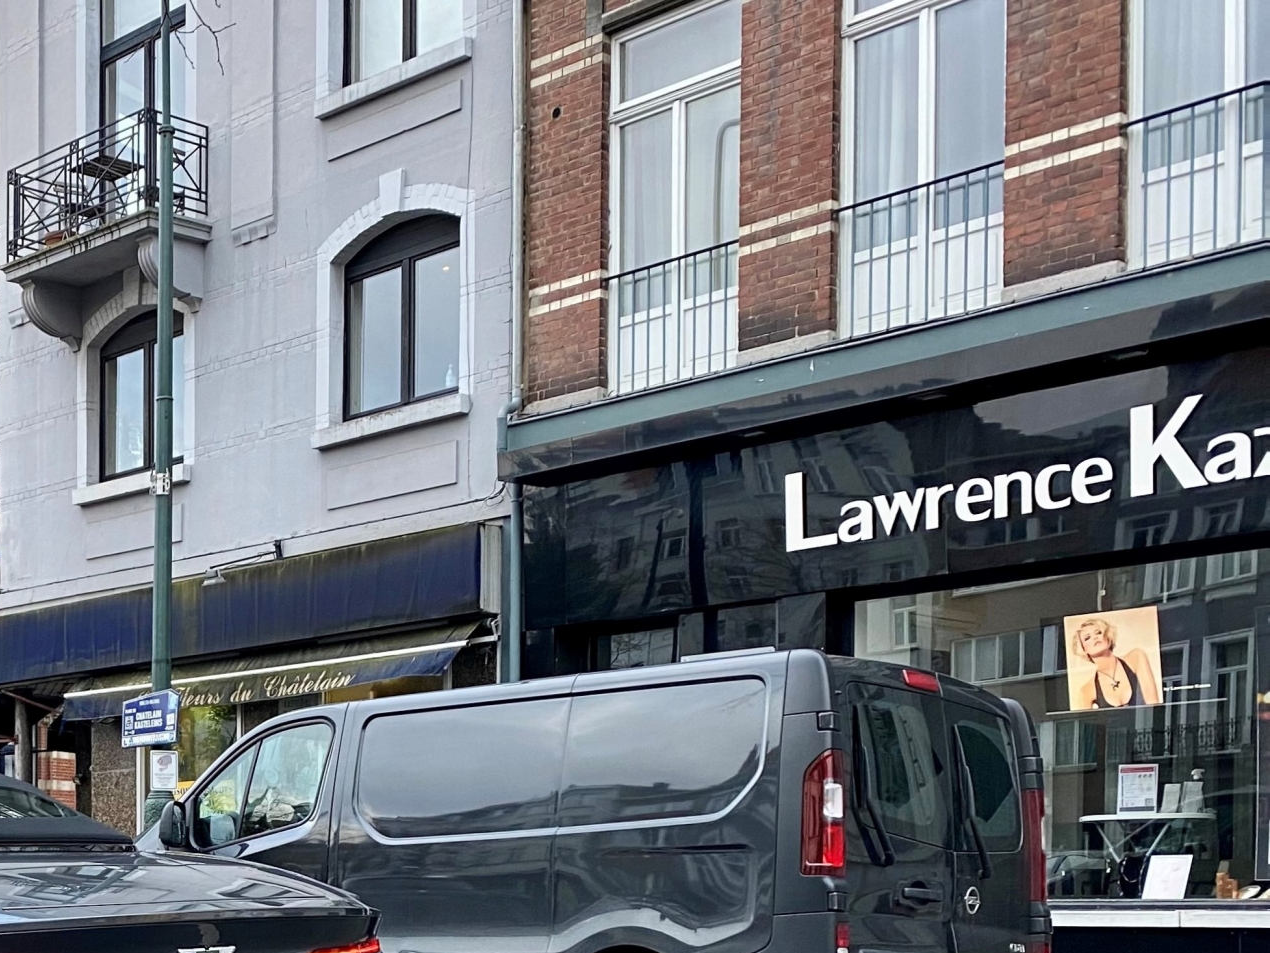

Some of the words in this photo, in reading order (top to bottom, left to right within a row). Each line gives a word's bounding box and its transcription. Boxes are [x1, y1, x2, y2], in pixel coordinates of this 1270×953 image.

[785, 456, 1114, 552] Lawrence
[231, 682, 255, 701] du
[263, 670, 357, 698] Châtelain
